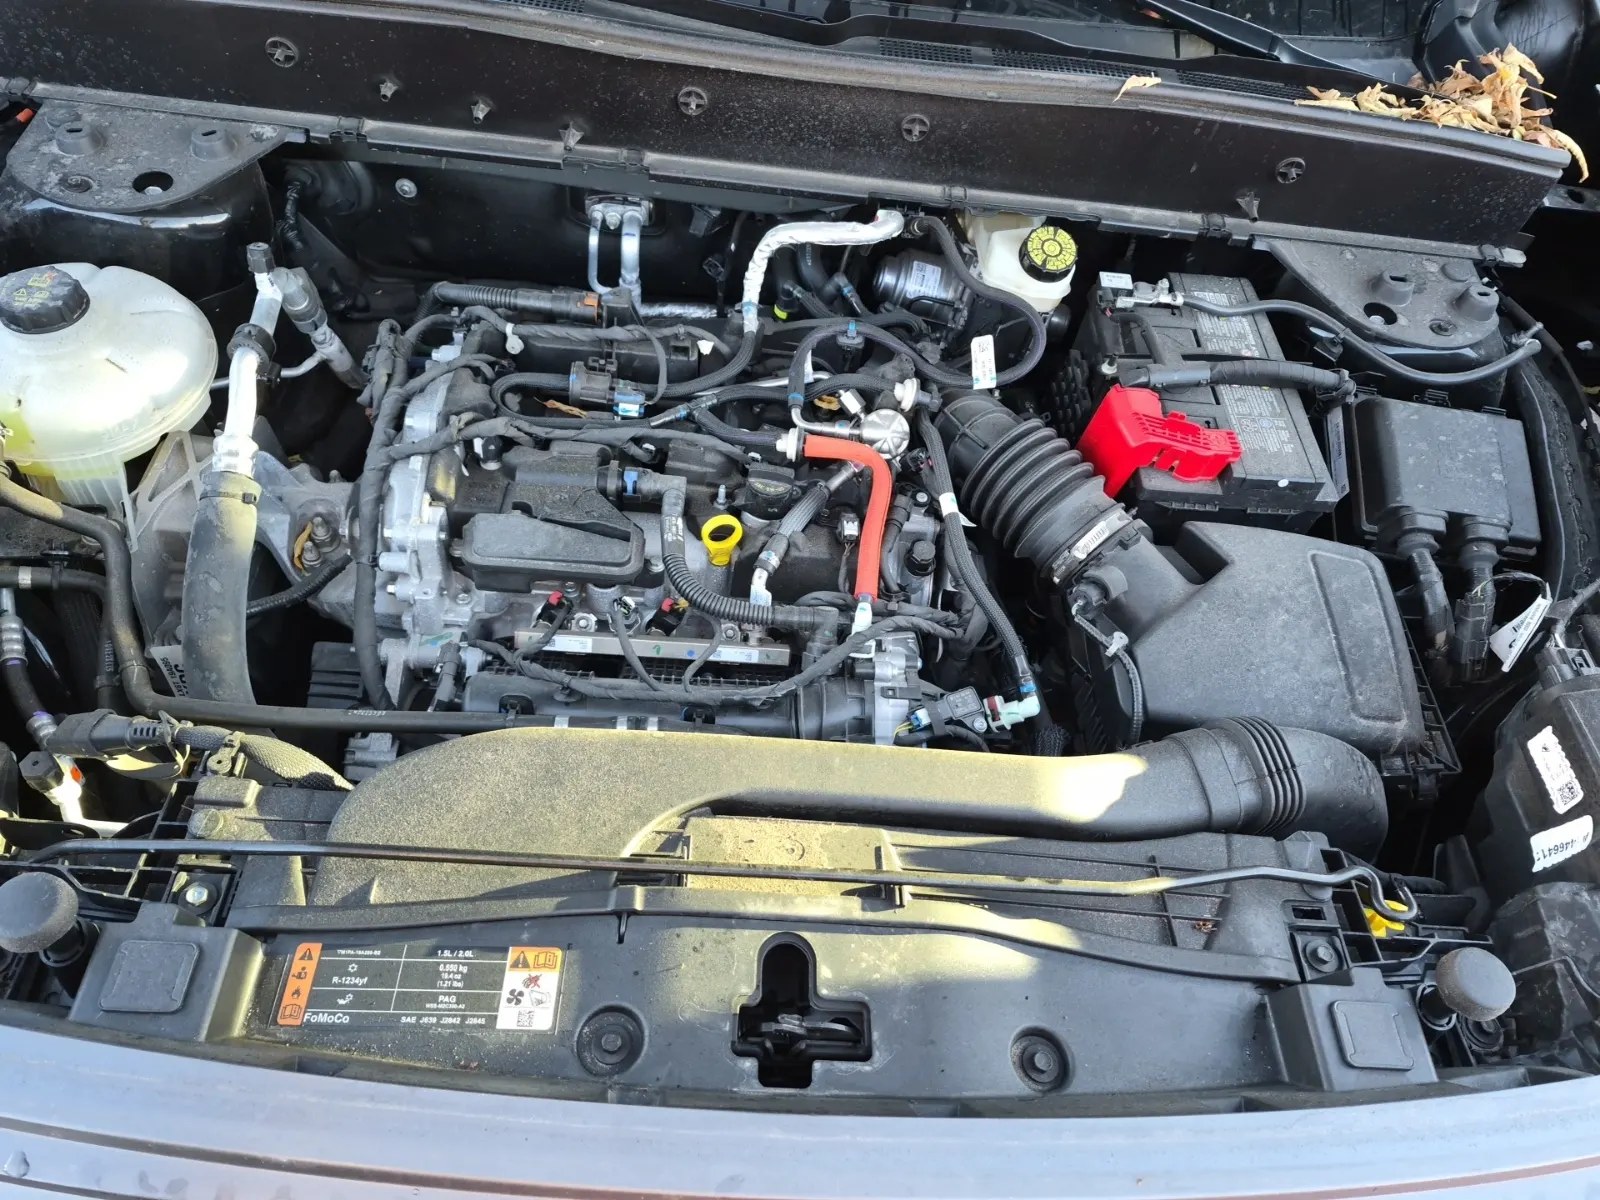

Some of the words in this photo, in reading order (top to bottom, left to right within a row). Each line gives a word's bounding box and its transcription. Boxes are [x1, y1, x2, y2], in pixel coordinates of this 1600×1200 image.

[437, 949, 452, 957] 1.5L
[458, 950, 475, 958] 2.0L
[458, 964, 468, 974] kg
[332, 976, 368, 986] R-1234yf
[438, 995, 457, 1003] PAG
[303, 1012, 350, 1024] FoMoCo
[400, 1016, 417, 1024] SAE
